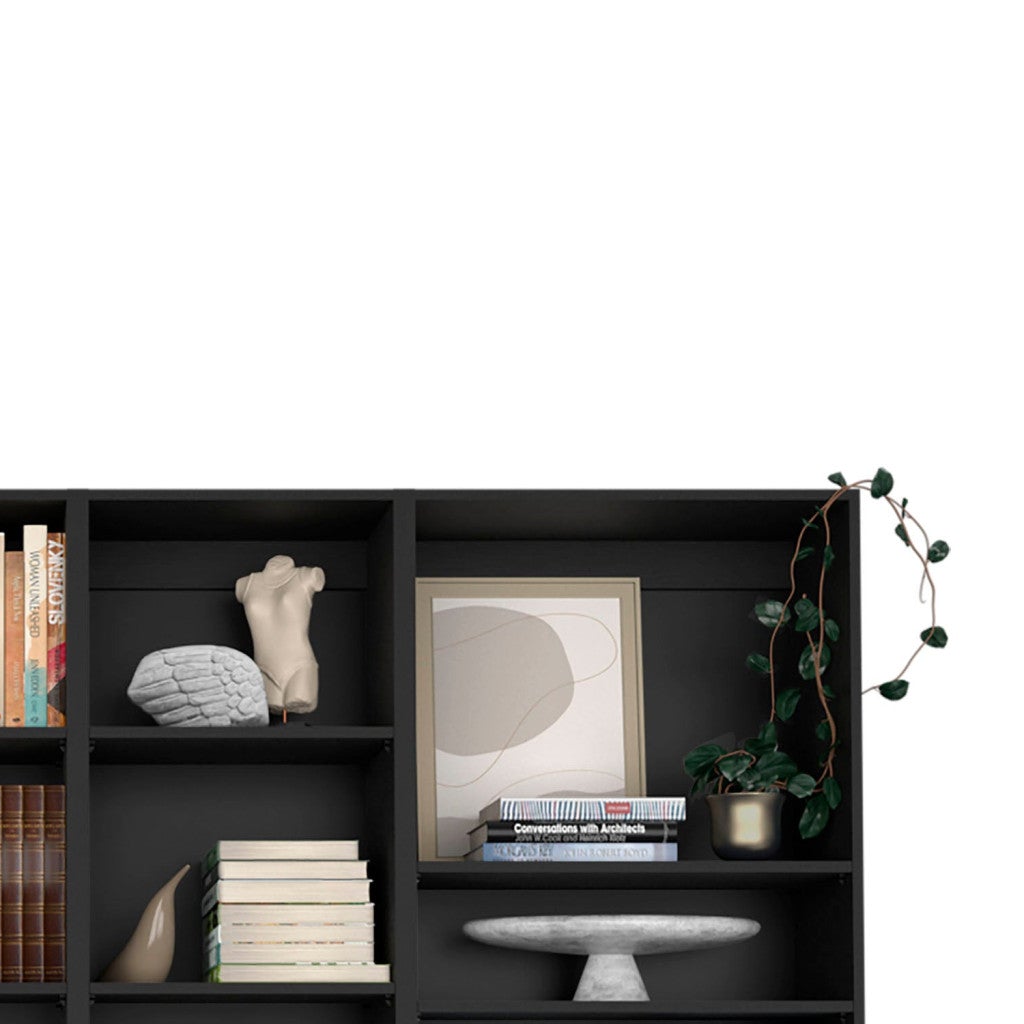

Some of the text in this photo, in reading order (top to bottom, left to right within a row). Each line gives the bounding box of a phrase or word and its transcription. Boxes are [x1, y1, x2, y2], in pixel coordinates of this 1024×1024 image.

[29, 551, 40, 638] WOMAN UNLEASHED
[48, 540, 64, 625] SLOVENKY
[514, 823, 646, 834] Conversations with Architects
